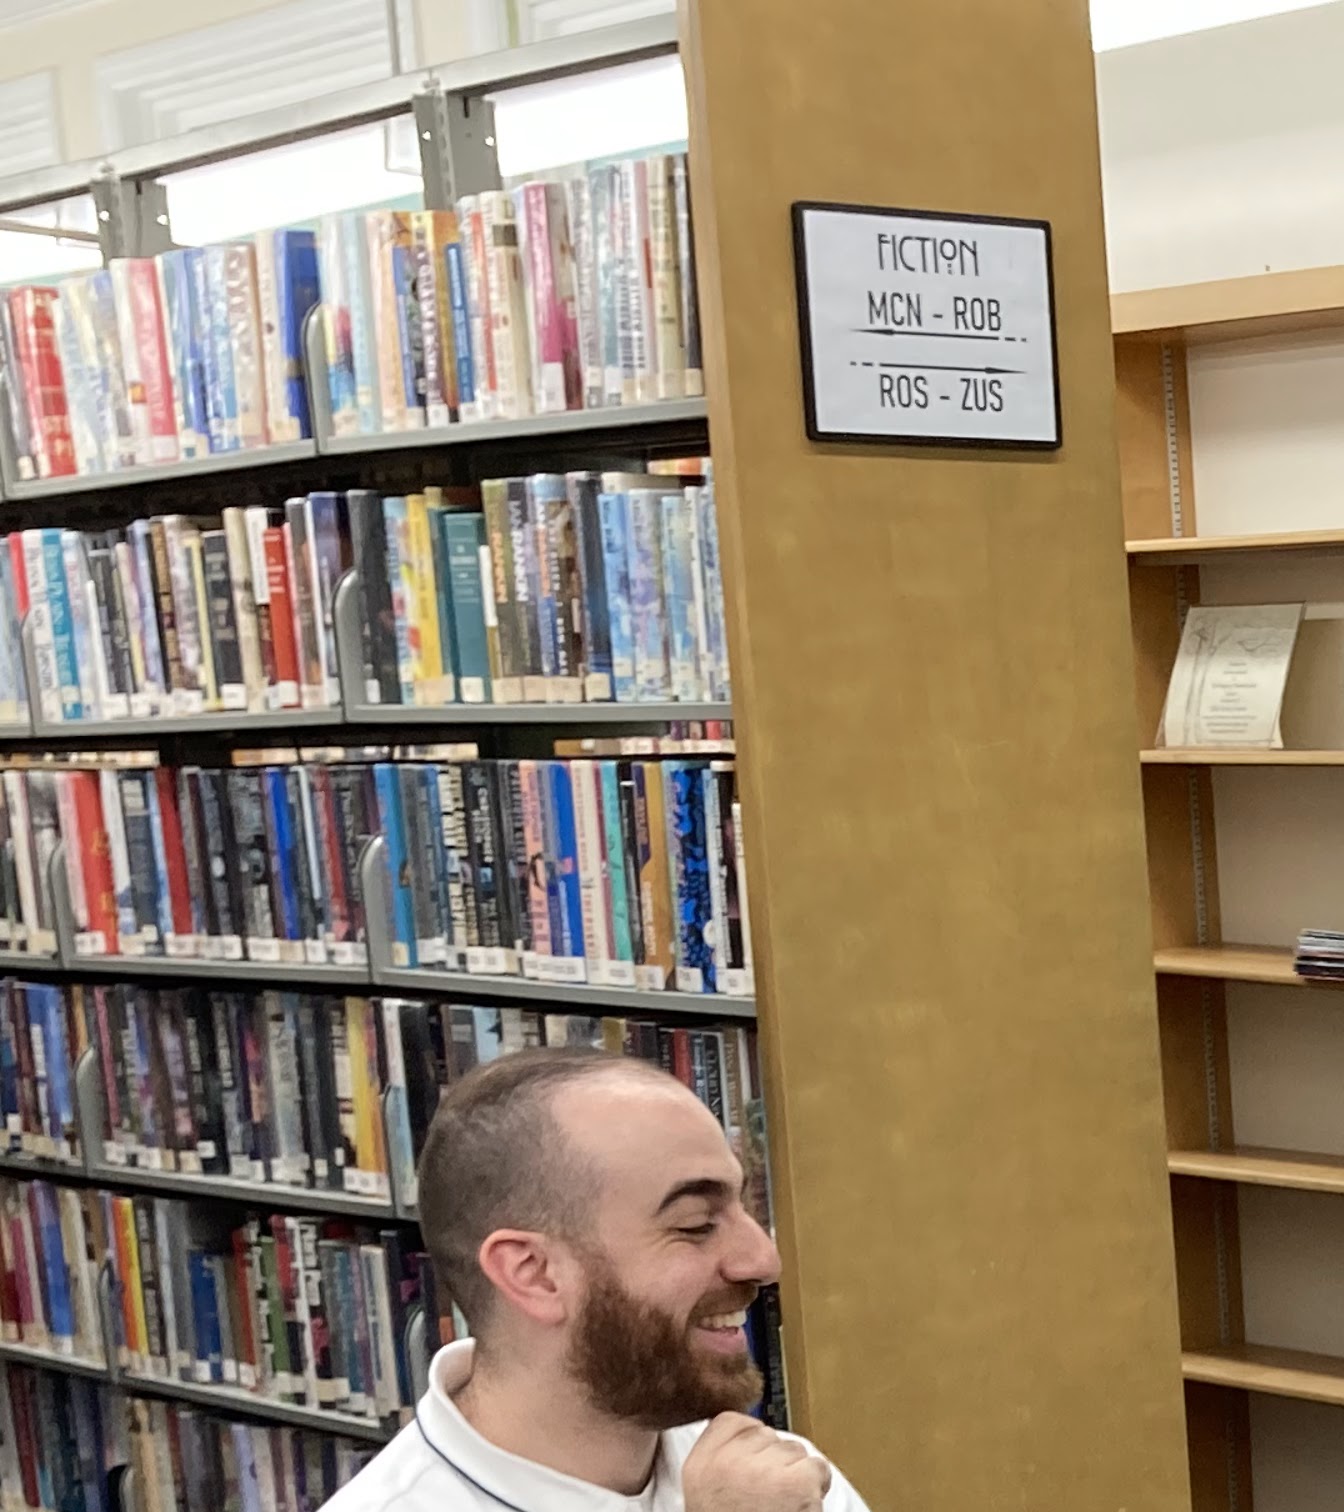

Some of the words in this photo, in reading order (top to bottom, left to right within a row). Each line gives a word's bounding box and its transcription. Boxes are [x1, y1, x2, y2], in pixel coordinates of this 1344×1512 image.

[877, 233, 980, 277] FICTION
[867, 290, 923, 327] MCN
[953, 296, 1002, 331] ROB
[879, 374, 929, 409] ROS
[960, 378, 1004, 413] ZUS
